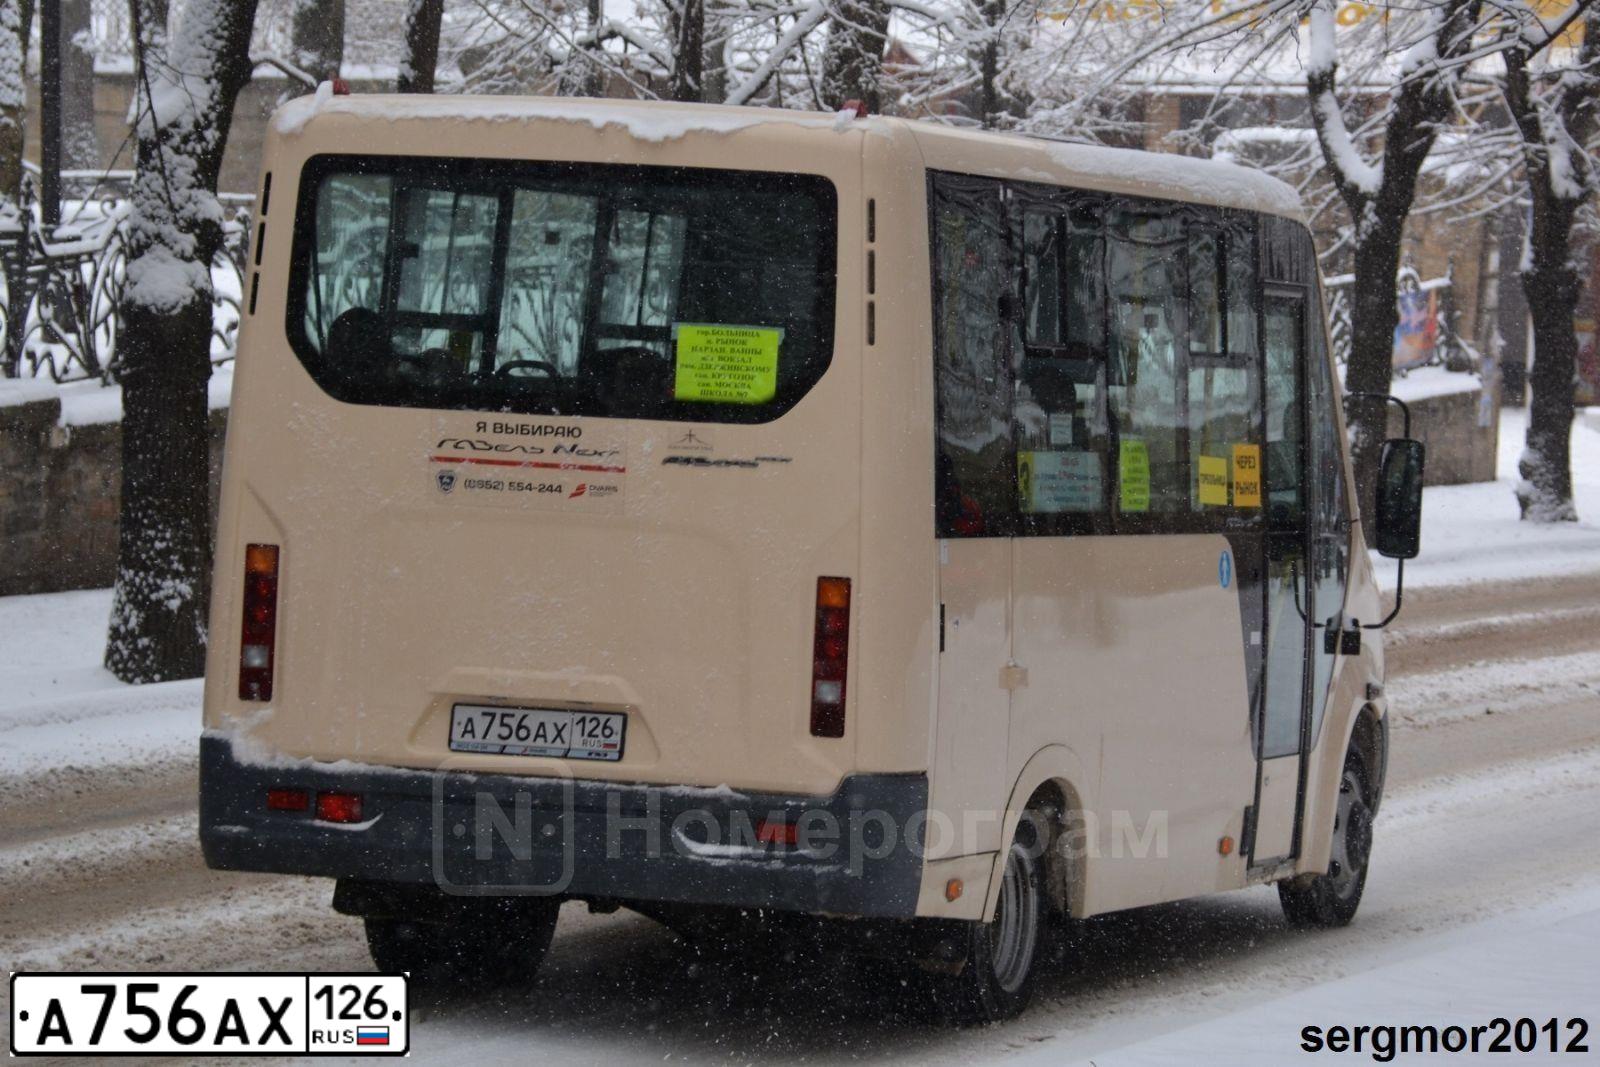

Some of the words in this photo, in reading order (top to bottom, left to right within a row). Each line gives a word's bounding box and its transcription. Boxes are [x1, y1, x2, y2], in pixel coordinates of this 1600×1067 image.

[476, 421, 487, 433] Я
[493, 422, 582, 438] ВЫБИРАЮ
[508, 479, 563, 494] 554-244
[461, 711, 568, 745] А756АХ
[575, 715, 615, 740] 126
[581, 739, 603, 748] RUS
